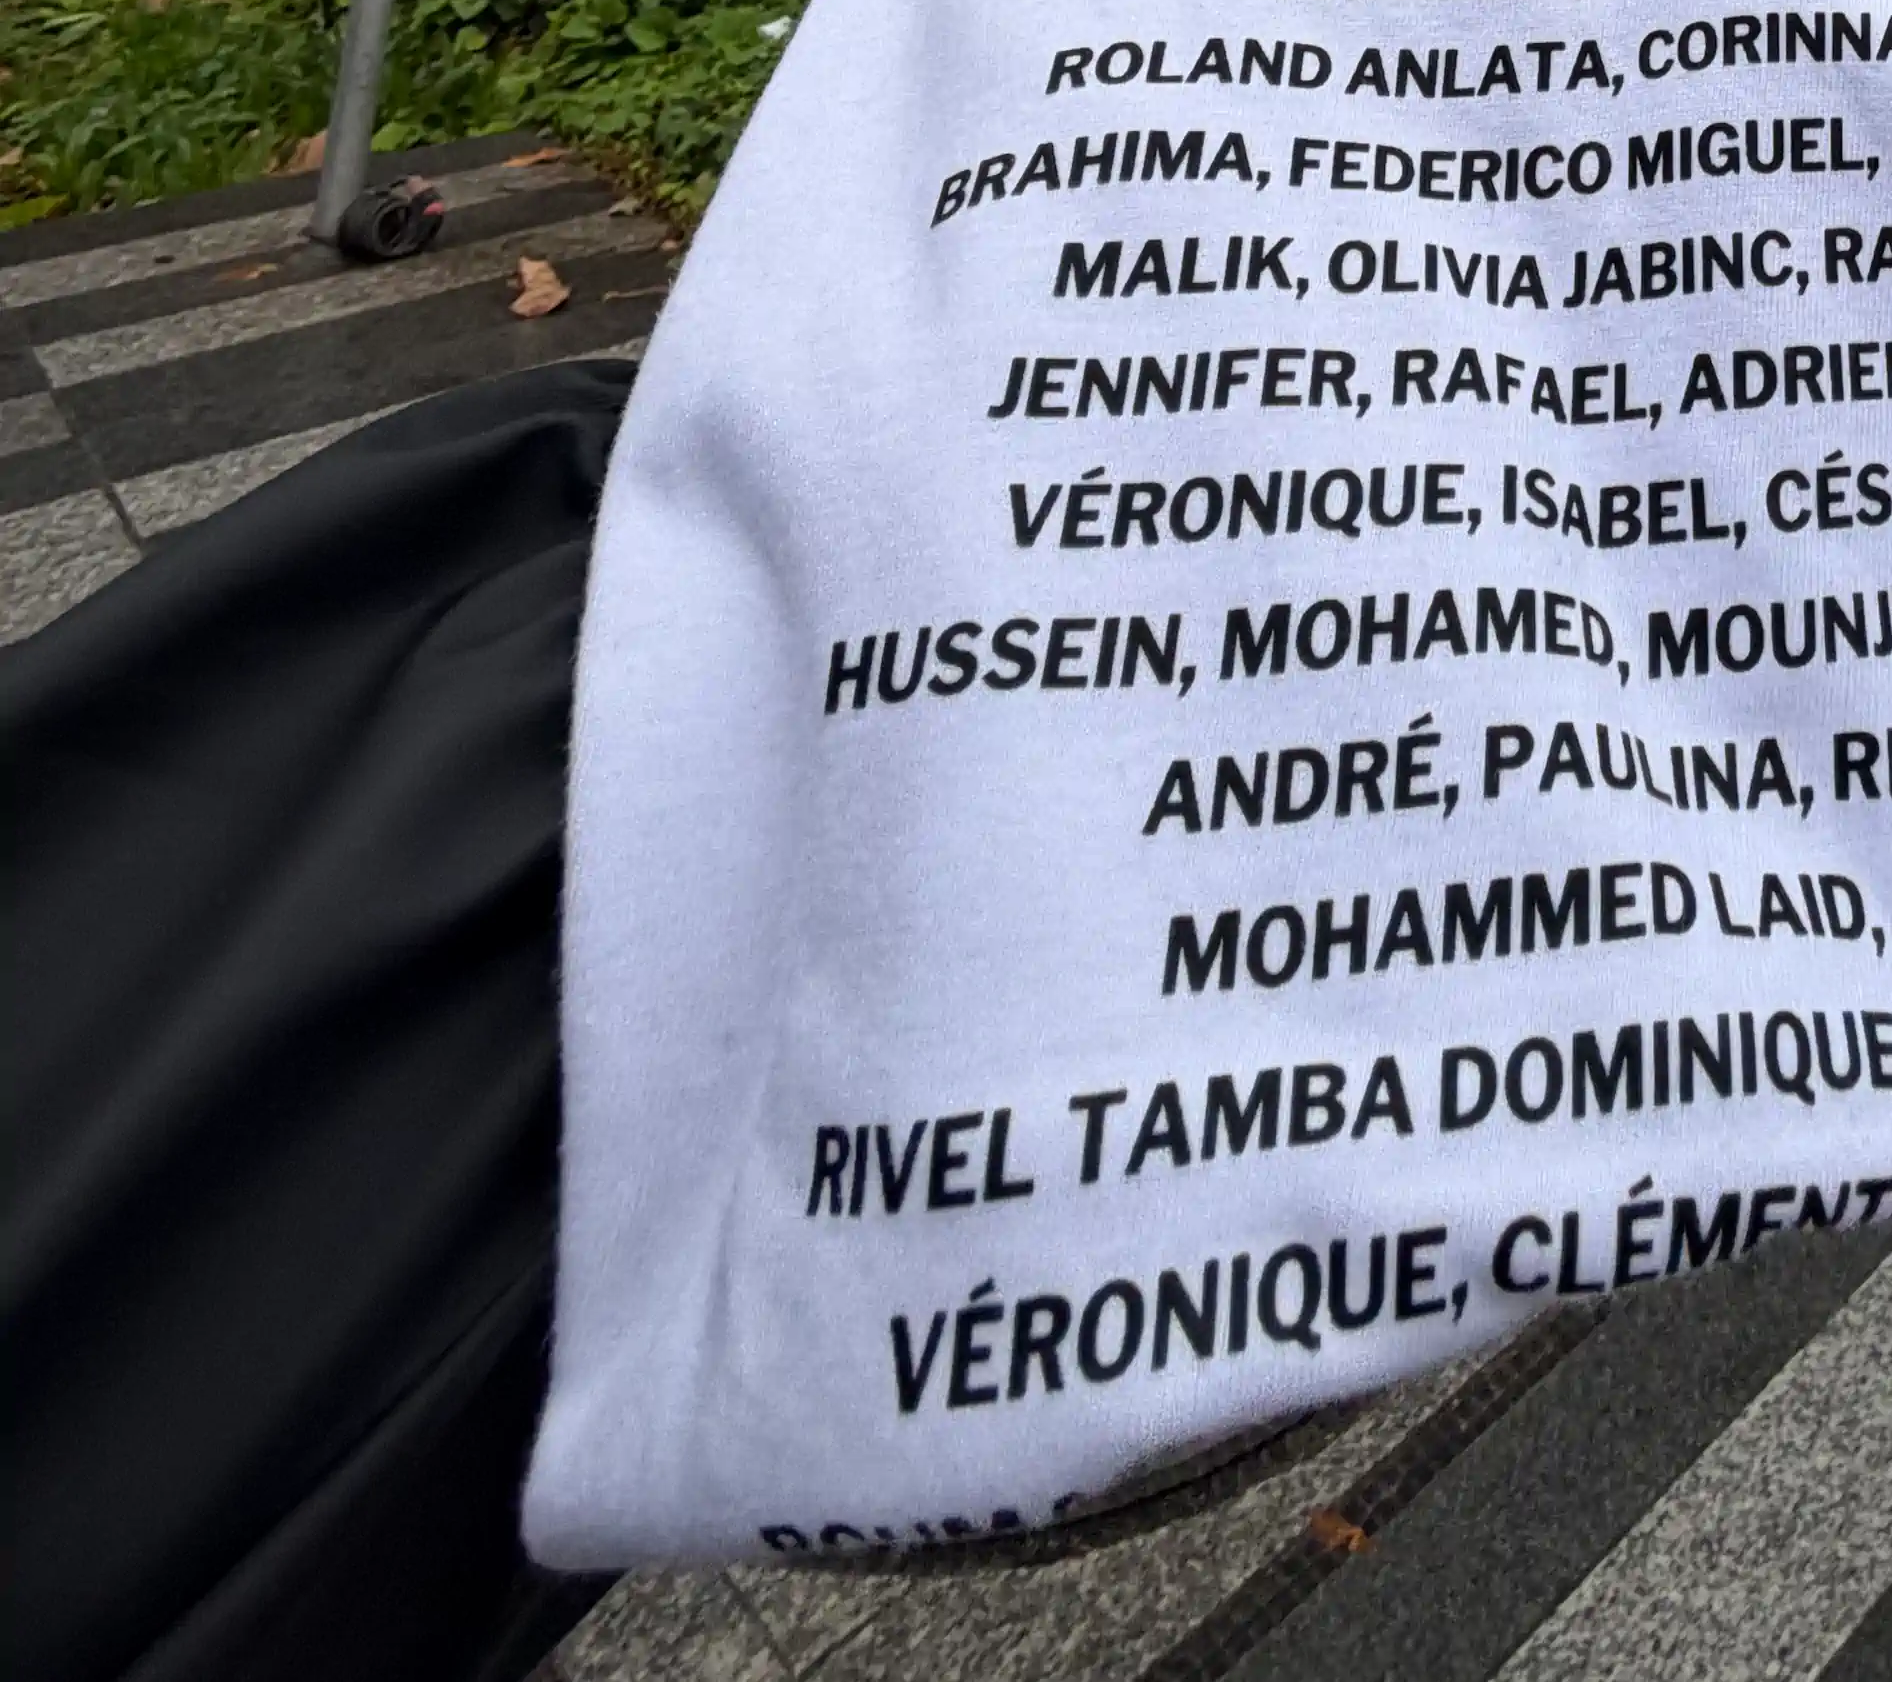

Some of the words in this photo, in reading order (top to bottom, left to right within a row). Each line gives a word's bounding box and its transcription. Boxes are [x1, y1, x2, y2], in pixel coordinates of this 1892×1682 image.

[1046, 38, 1332, 95] ROLAND
[1345, 40, 1624, 98] ANLATA,
[930, 130, 1270, 229] BRAHIMA,
[1289, 137, 1612, 202] FEDERICO
[1628, 117, 1879, 191] MIGUEL,
[1053, 236, 1309, 300] MALIK,
[1328, 240, 1548, 309] OLIVIA
[1563, 230, 1809, 308] JABINC,
[987, 348, 1371, 418] JENNIFER,
[1392, 348, 1662, 431] RAFAEL,
[1009, 464, 1481, 548] VÉRONIQUE,
[1503, 465, 1747, 550] ISABEL,
[824, 614, 1196, 716] HUSSEIN,
[1220, 587, 1629, 687] MOHAMED,
[1142, 712, 1459, 836] ANDRÉ,
[1483, 722, 1814, 819] PAULINA,
[1162, 862, 1696, 996] MOHAMMED
[1709, 872, 1885, 957] LAID,
[806, 1108, 1034, 1217] RIVEL
[1069, 1055, 1414, 1185] TAMBA
[890, 1225, 1468, 1415] VÉRONIQUE,
